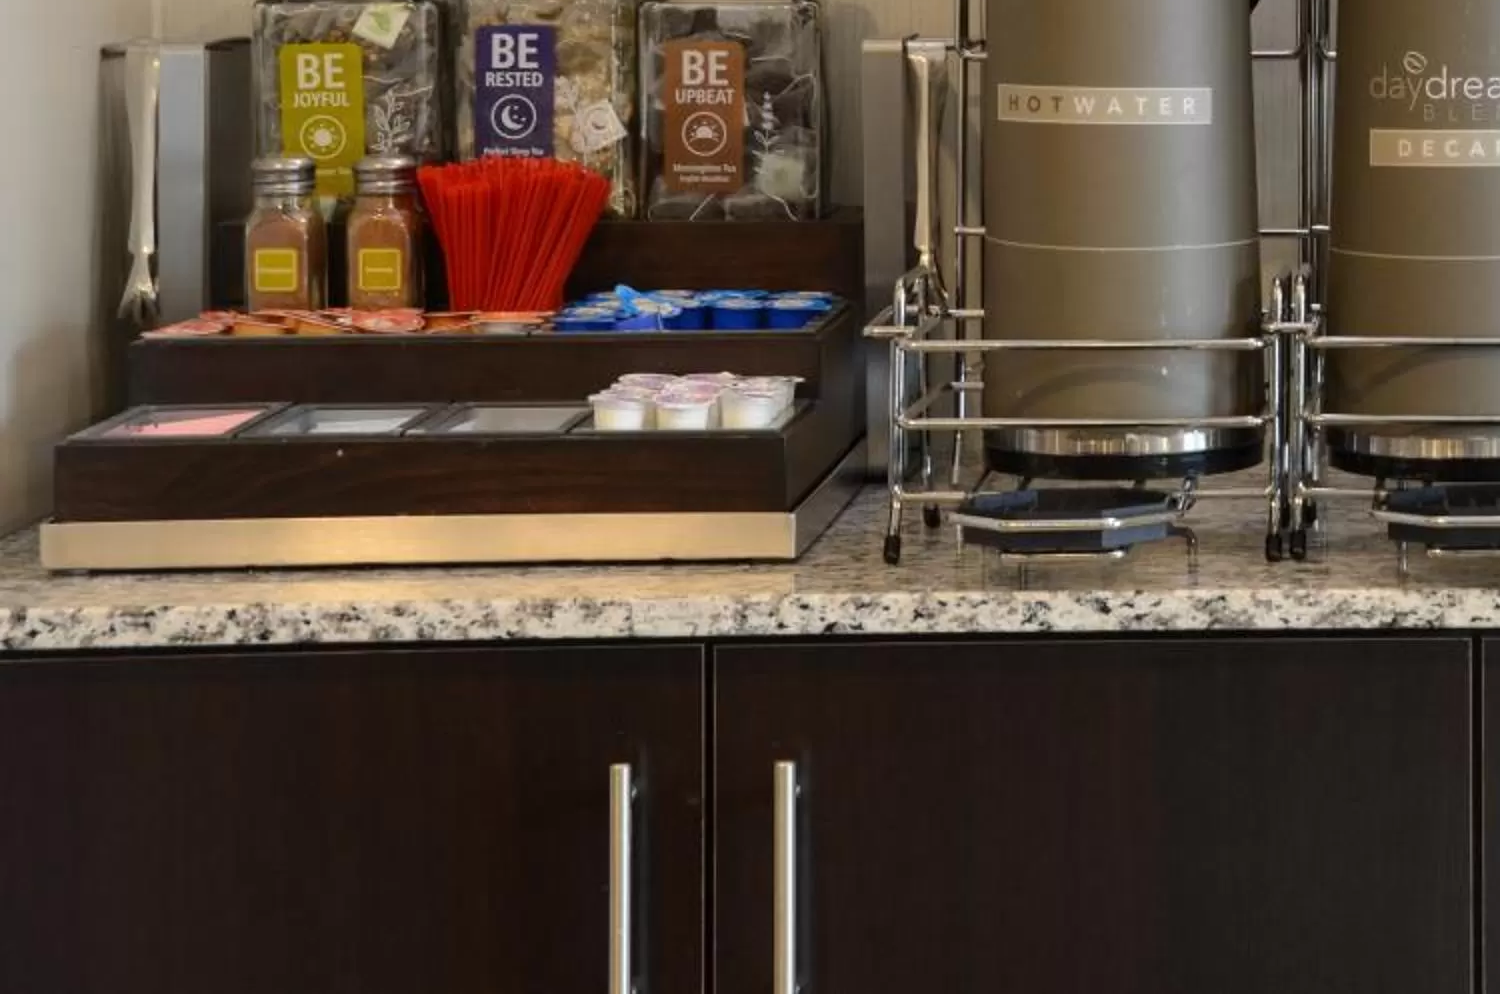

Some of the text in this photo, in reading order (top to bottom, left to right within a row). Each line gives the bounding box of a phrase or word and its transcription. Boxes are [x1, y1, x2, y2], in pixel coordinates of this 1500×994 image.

[491, 33, 539, 69] BE
[296, 53, 345, 89] BE
[681, 49, 729, 86] BE
[485, 71, 543, 87] RESTED
[293, 91, 351, 108] JOYFUL
[675, 89, 735, 105] UPBEAT
[1008, 94, 1196, 116] HOT WATER
